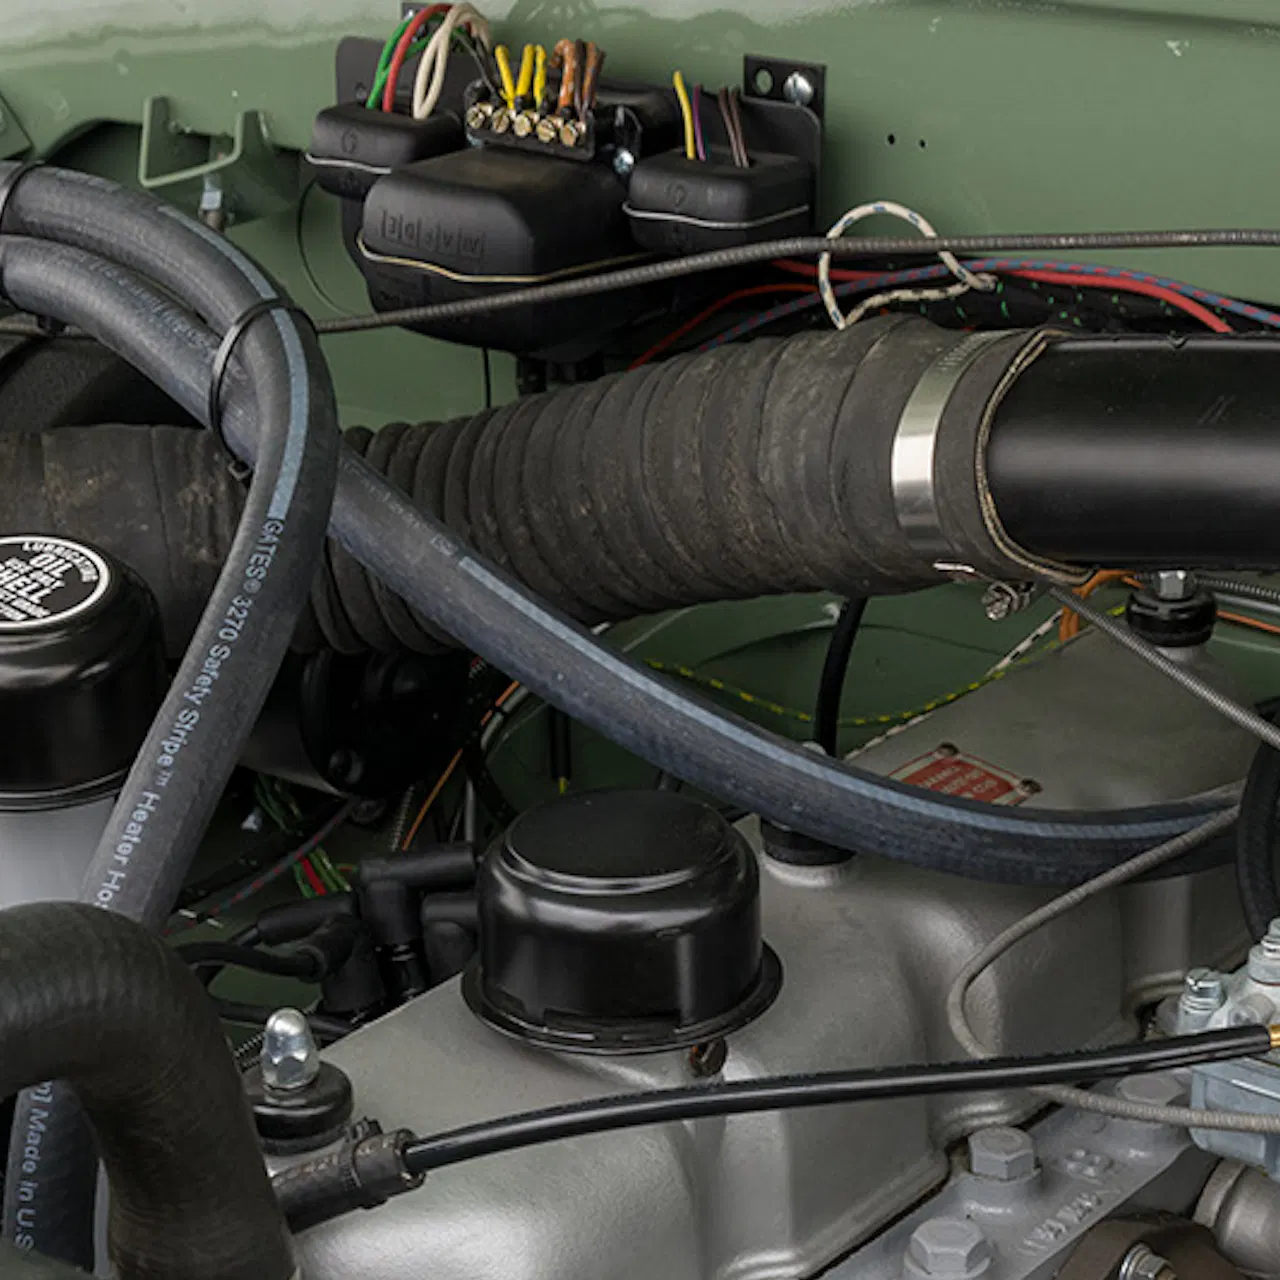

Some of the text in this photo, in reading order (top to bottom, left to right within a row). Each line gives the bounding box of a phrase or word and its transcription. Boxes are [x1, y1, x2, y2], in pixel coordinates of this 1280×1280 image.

[29, 552, 73, 578] OIL
[218, 595, 253, 641] 3270
[184, 644, 231, 706] Safety
[114, 790, 161, 866] Heater
[22, 1107, 50, 1174] Made
